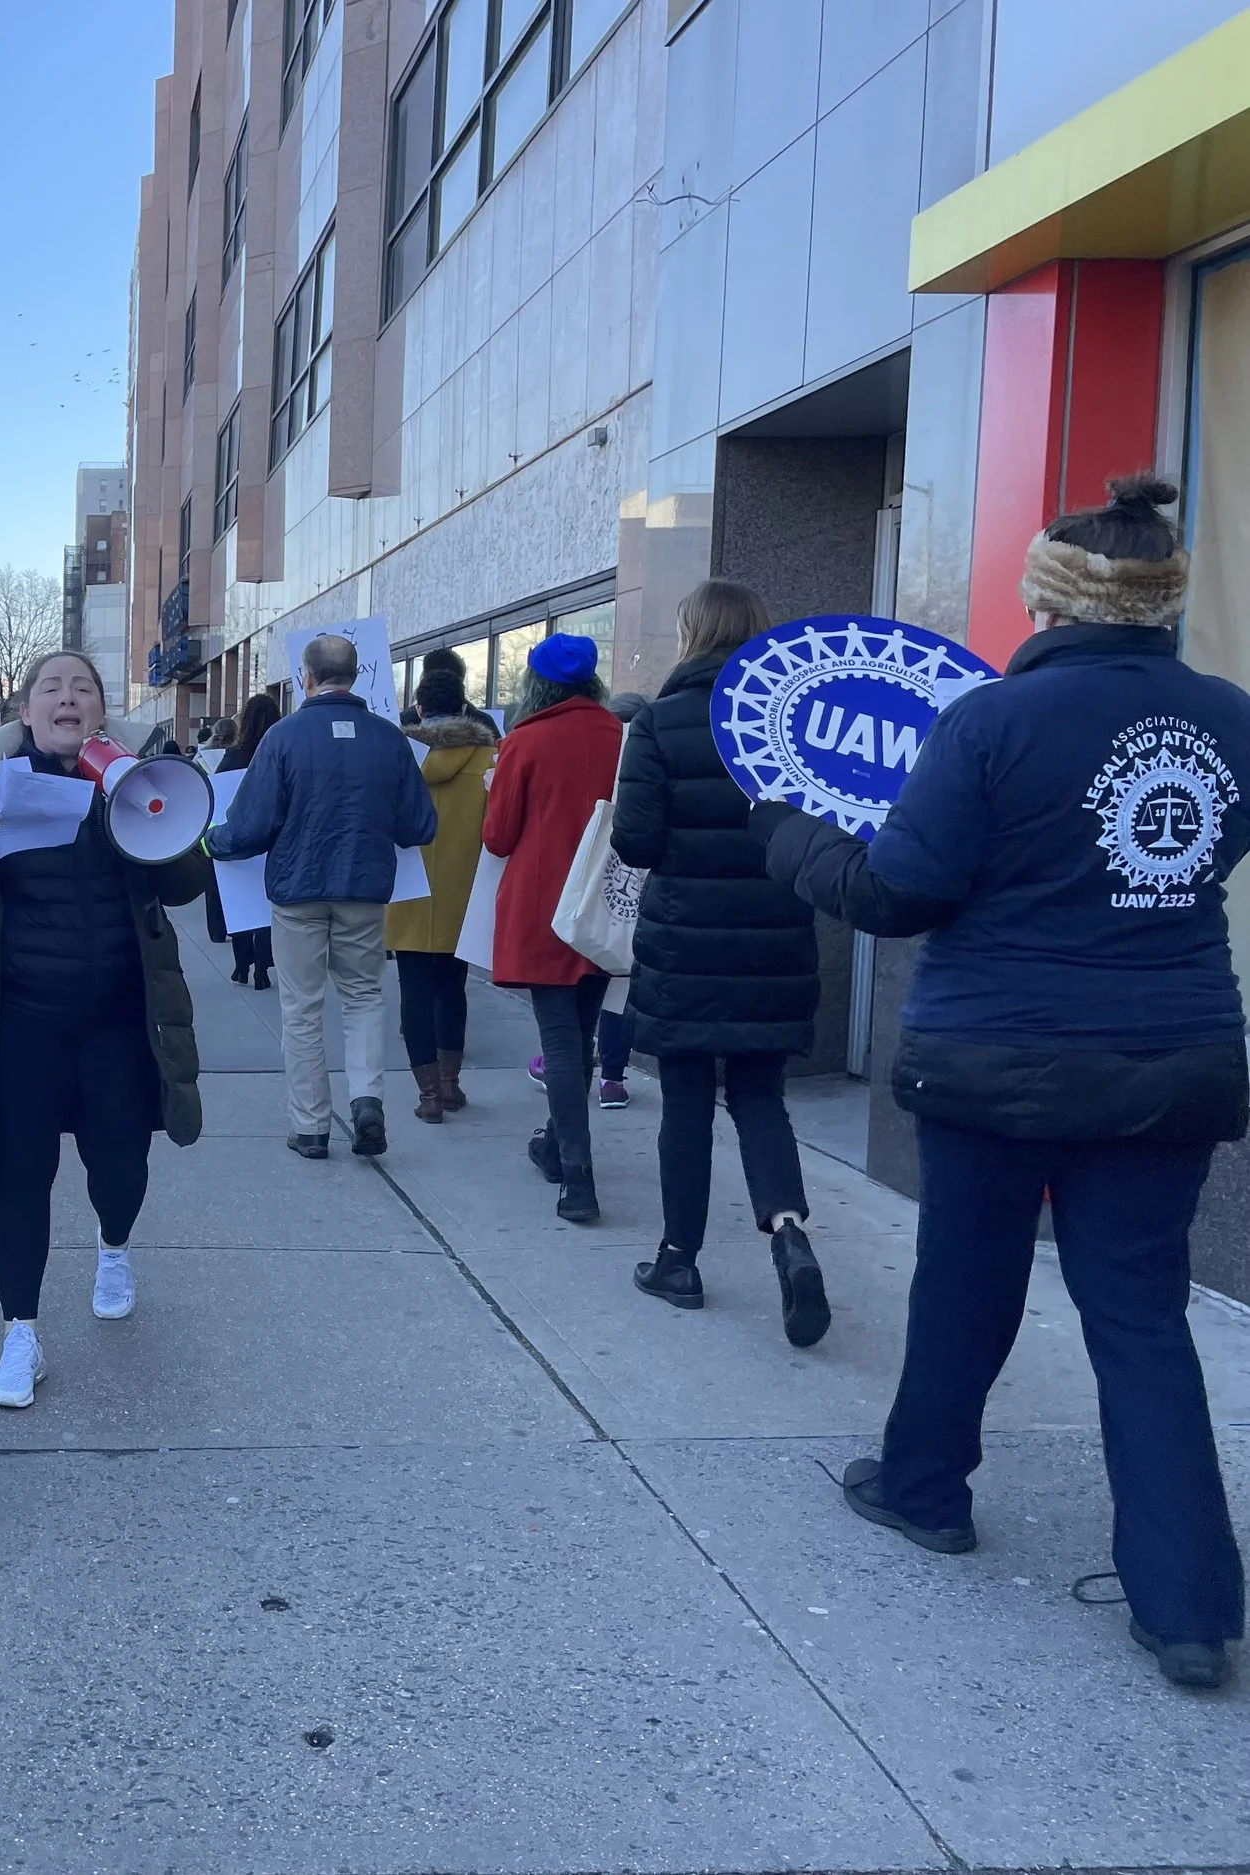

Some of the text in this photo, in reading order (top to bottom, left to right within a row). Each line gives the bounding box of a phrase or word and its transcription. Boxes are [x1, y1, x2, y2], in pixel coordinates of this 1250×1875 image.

[780, 662, 827, 694] AEROSPACE
[831, 659, 856, 668] AND
[860, 659, 934, 691] AGRICULTURA
[804, 699, 925, 774] UAW
[1111, 716, 1218, 749] ASSOCIATION OF
[779, 755, 808, 787] UNITED
[1081, 730, 1240, 809] LEGAL AID ATTORNEYS
[604, 887, 617, 910] UAW
[617, 907, 639, 918] 232
[1110, 893, 1196, 908] UAW 2325
